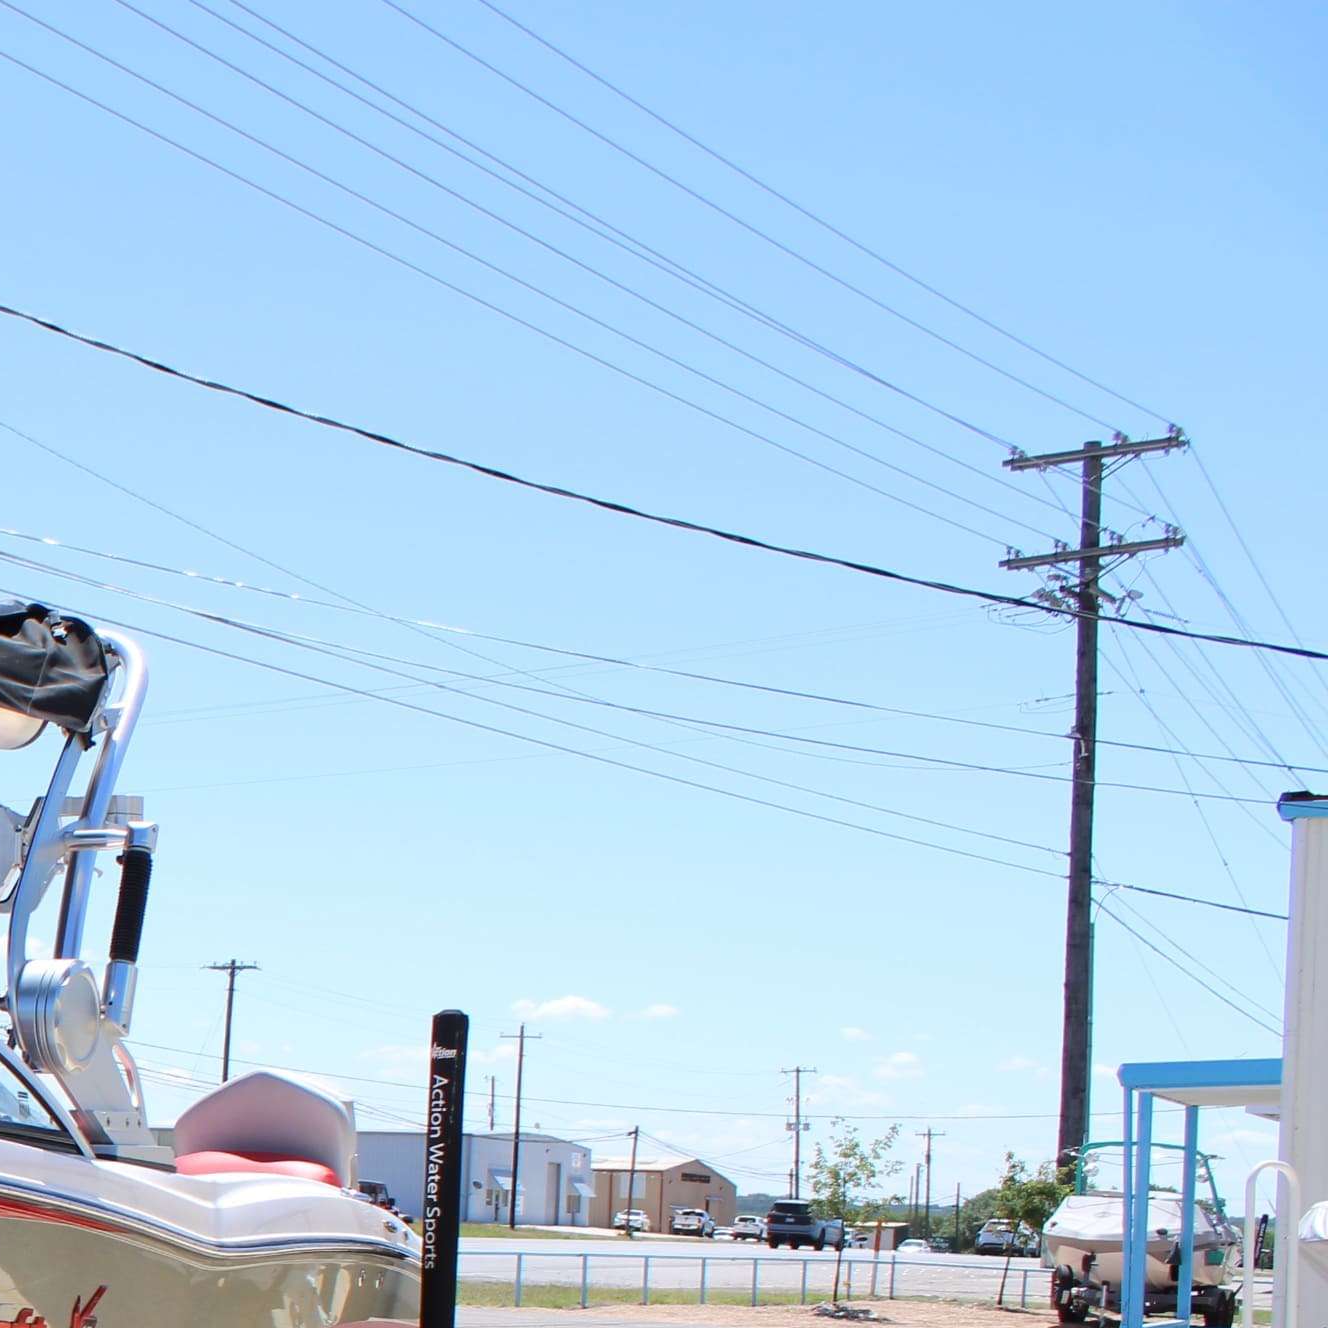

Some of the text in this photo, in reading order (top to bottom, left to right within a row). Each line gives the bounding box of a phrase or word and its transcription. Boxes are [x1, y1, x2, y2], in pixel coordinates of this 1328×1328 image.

[424, 1074, 448, 1269] Action Water Sports
